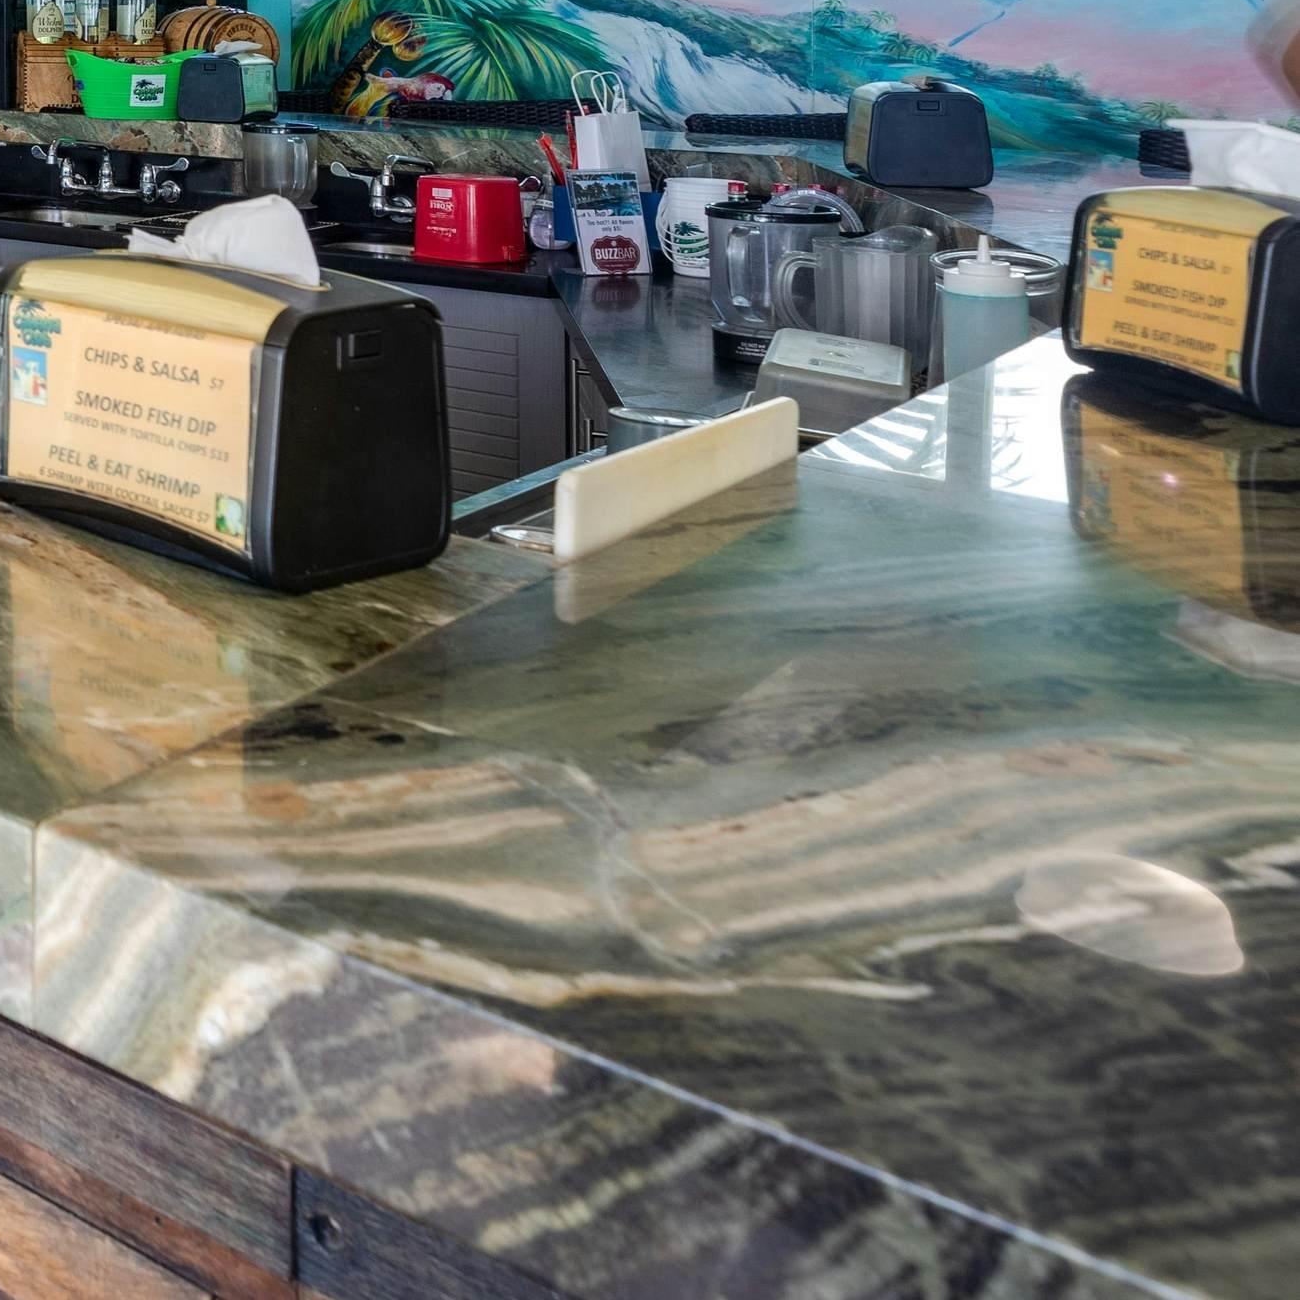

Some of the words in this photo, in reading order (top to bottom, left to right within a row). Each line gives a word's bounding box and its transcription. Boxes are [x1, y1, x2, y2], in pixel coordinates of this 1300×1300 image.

[84, 347, 129, 373] CHIPS
[133, 357, 148, 373] &
[150, 360, 200, 385] SALSA
[63, 411, 100, 429] SERVED
[101, 420, 128, 436] WITH
[129, 428, 175, 448] TORTILLA
[177, 440, 208, 456] CHIPS
[74, 390, 143, 419] SMOKED
[147, 406, 183, 429] FISH
[187, 417, 217, 437] DIP
[39, 466, 45, 476] 6
[46, 468, 85, 486] SHRIMP
[86, 477, 114, 495] WITH
[114, 487, 161, 510] COCKTAIL
[162, 499, 195, 518] SAUCE
[48, 444, 82, 468] PEEL
[86, 455, 100, 472] &
[104, 458, 133, 478] EAT
[135, 466, 201, 500] SHRIMP
